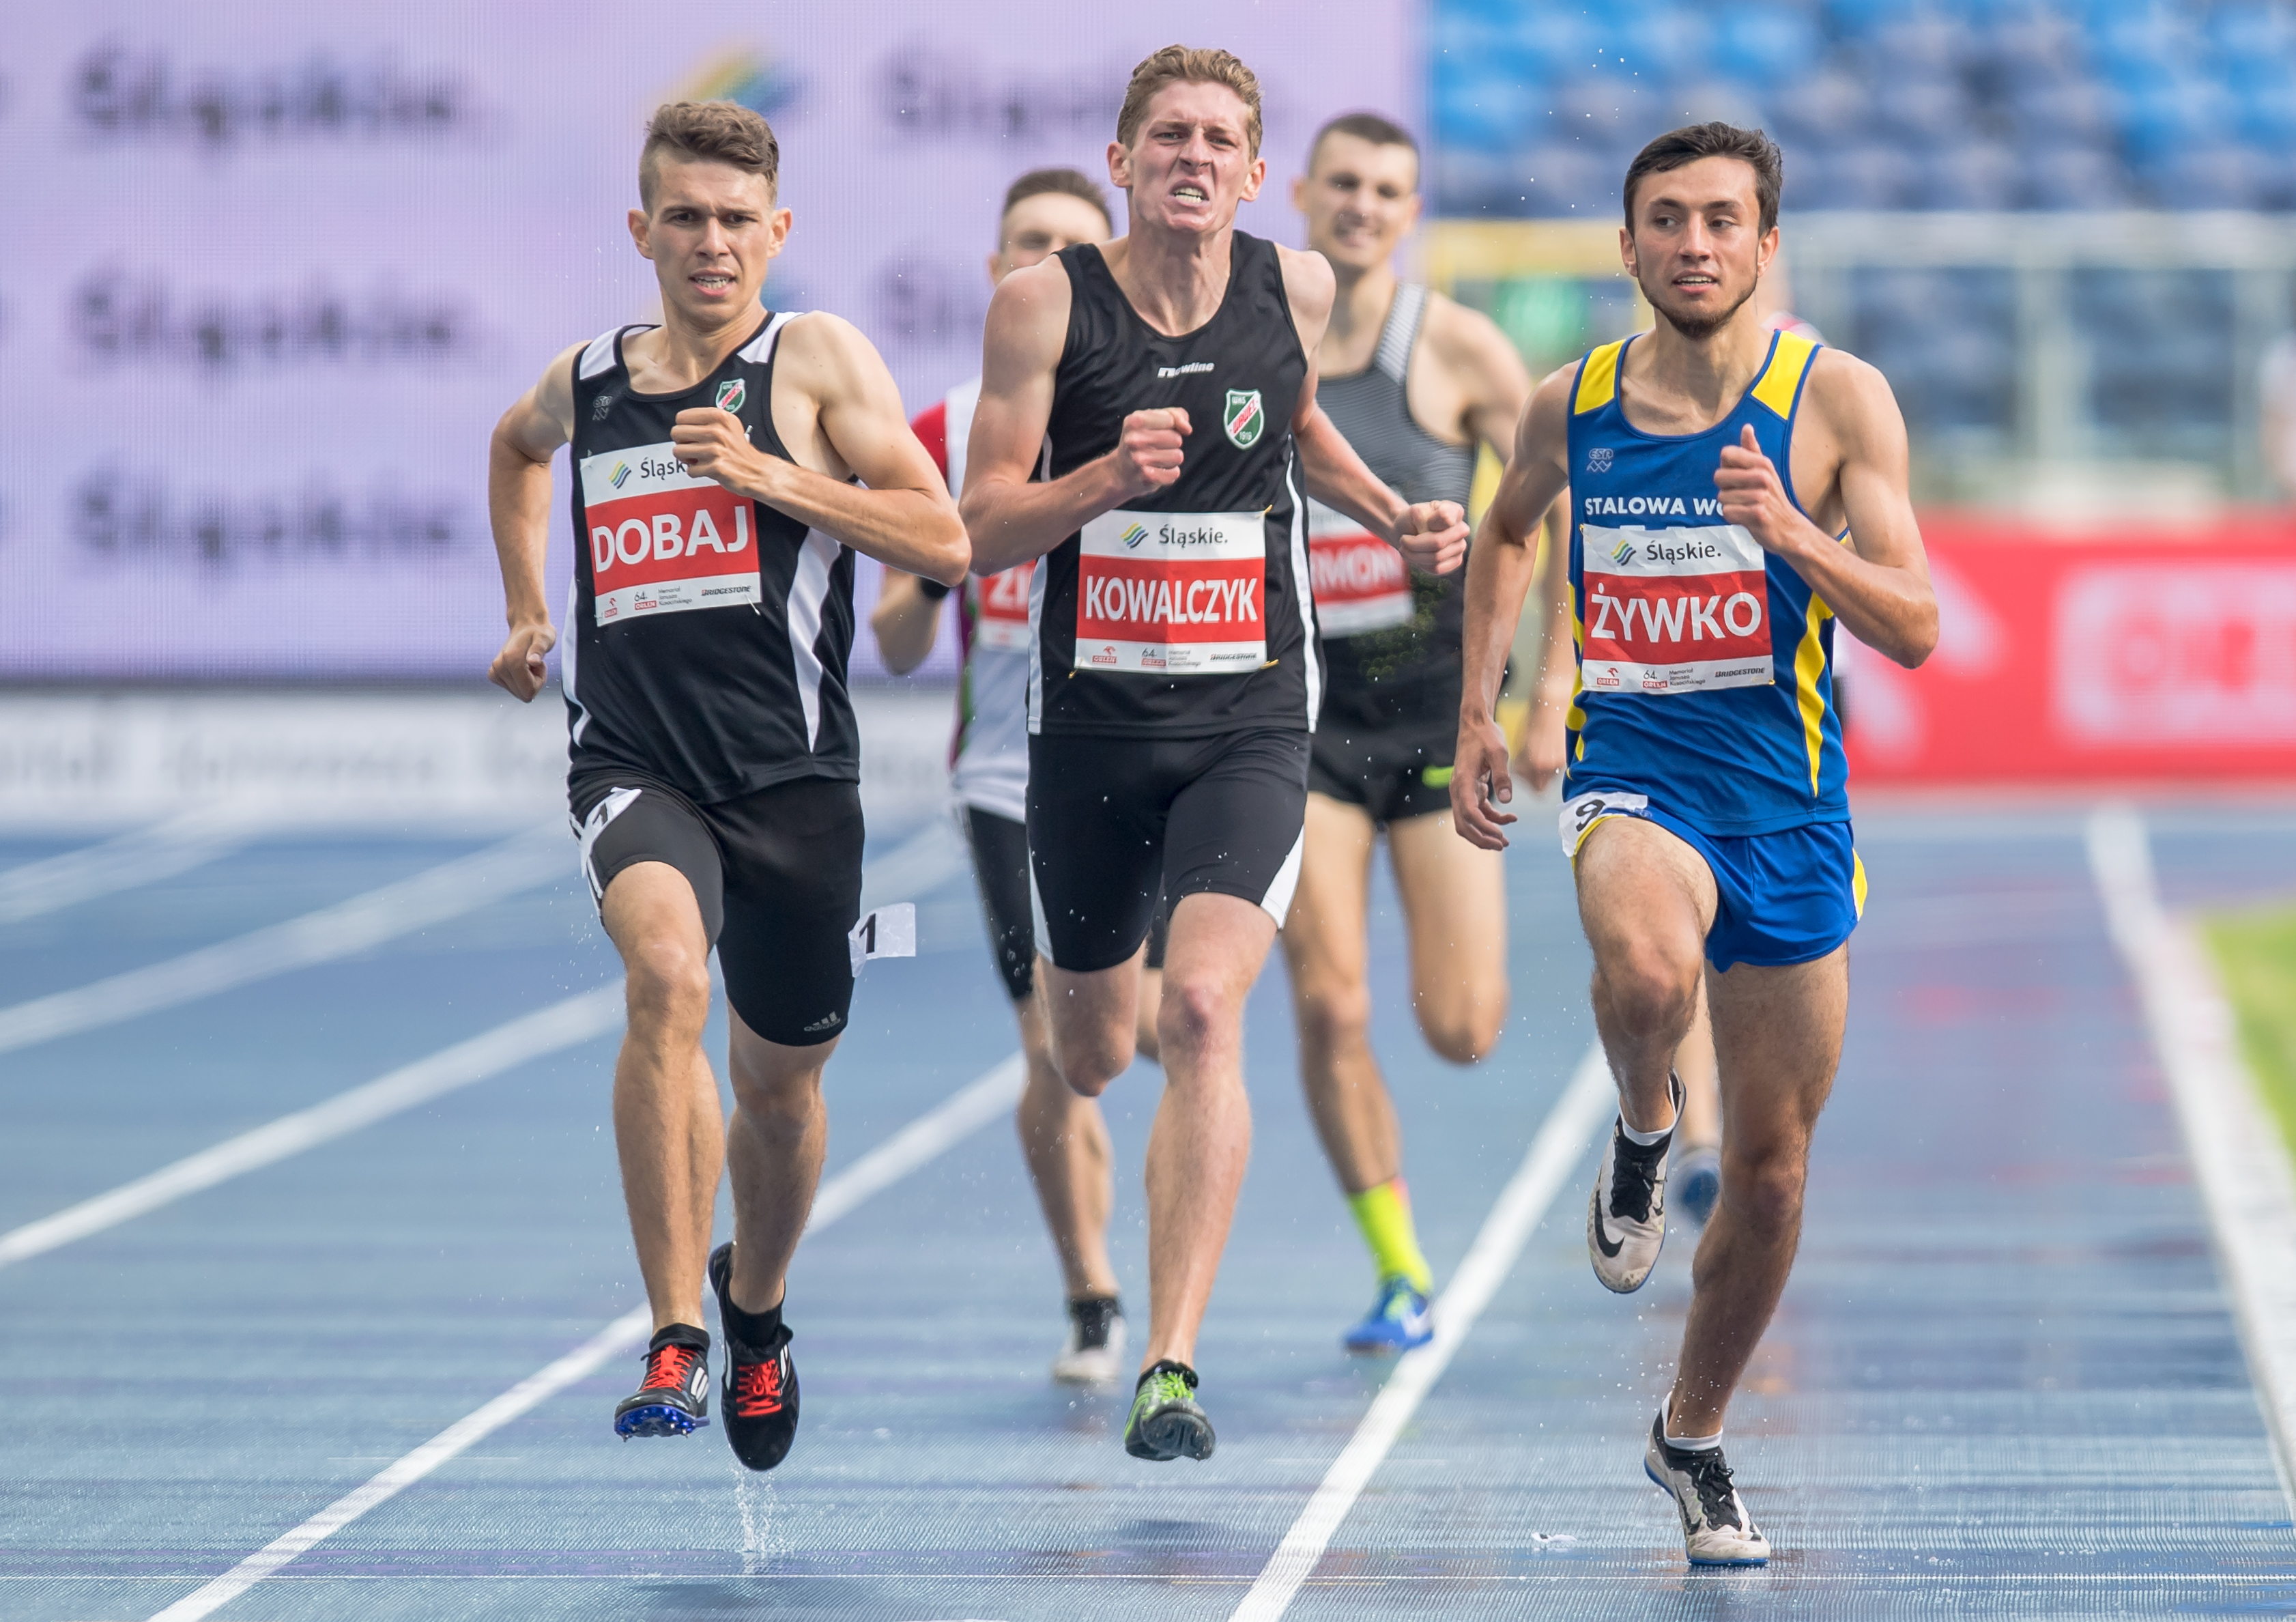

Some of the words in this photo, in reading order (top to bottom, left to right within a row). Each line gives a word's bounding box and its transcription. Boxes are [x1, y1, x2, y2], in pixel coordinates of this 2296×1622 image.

[1157, 362, 1215, 378] newline
[1585, 497, 1687, 515] STALOWA
[592, 505, 748, 573] DOBAJ
[1646, 540, 1721, 565] Śląskie.
[701, 586, 751, 596] BRIDGESTONE
[1085, 575, 1258, 624] KOWALCZYK
[1591, 582, 1762, 643] ŻYWKO
[1644, 670, 1657, 679] 64.
[1714, 668, 1765, 677] BRIDGESTONE
[1576, 799, 1605, 831] 9
[859, 913, 876, 954] 1
